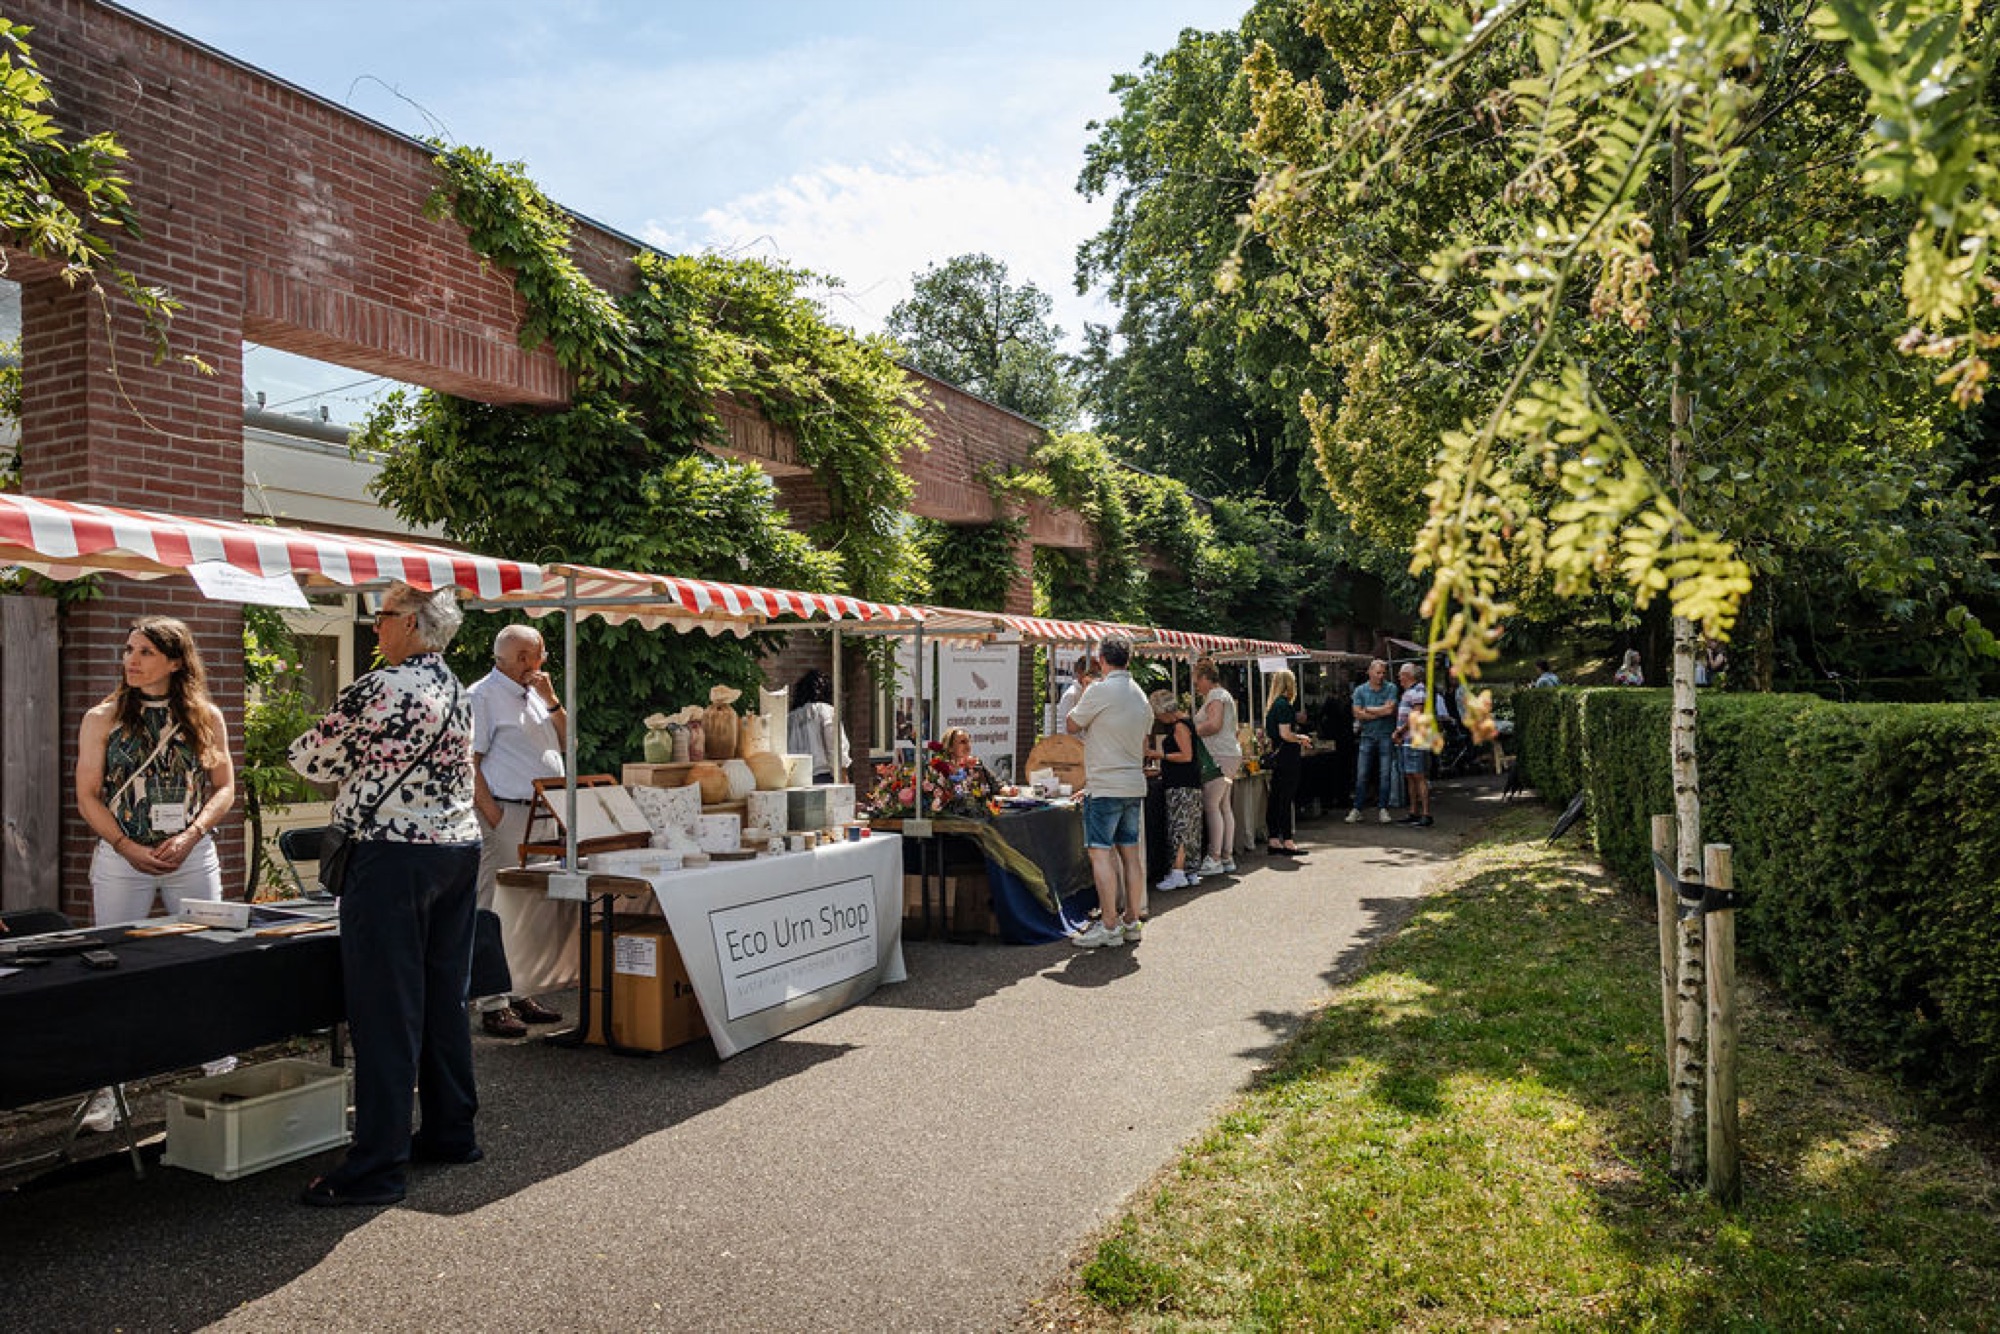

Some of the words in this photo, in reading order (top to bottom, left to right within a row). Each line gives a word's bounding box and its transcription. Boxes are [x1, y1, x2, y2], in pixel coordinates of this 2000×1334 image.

[726, 930, 768, 962] Eco
[773, 916, 815, 947] Urn
[820, 900, 869, 936] Shop
